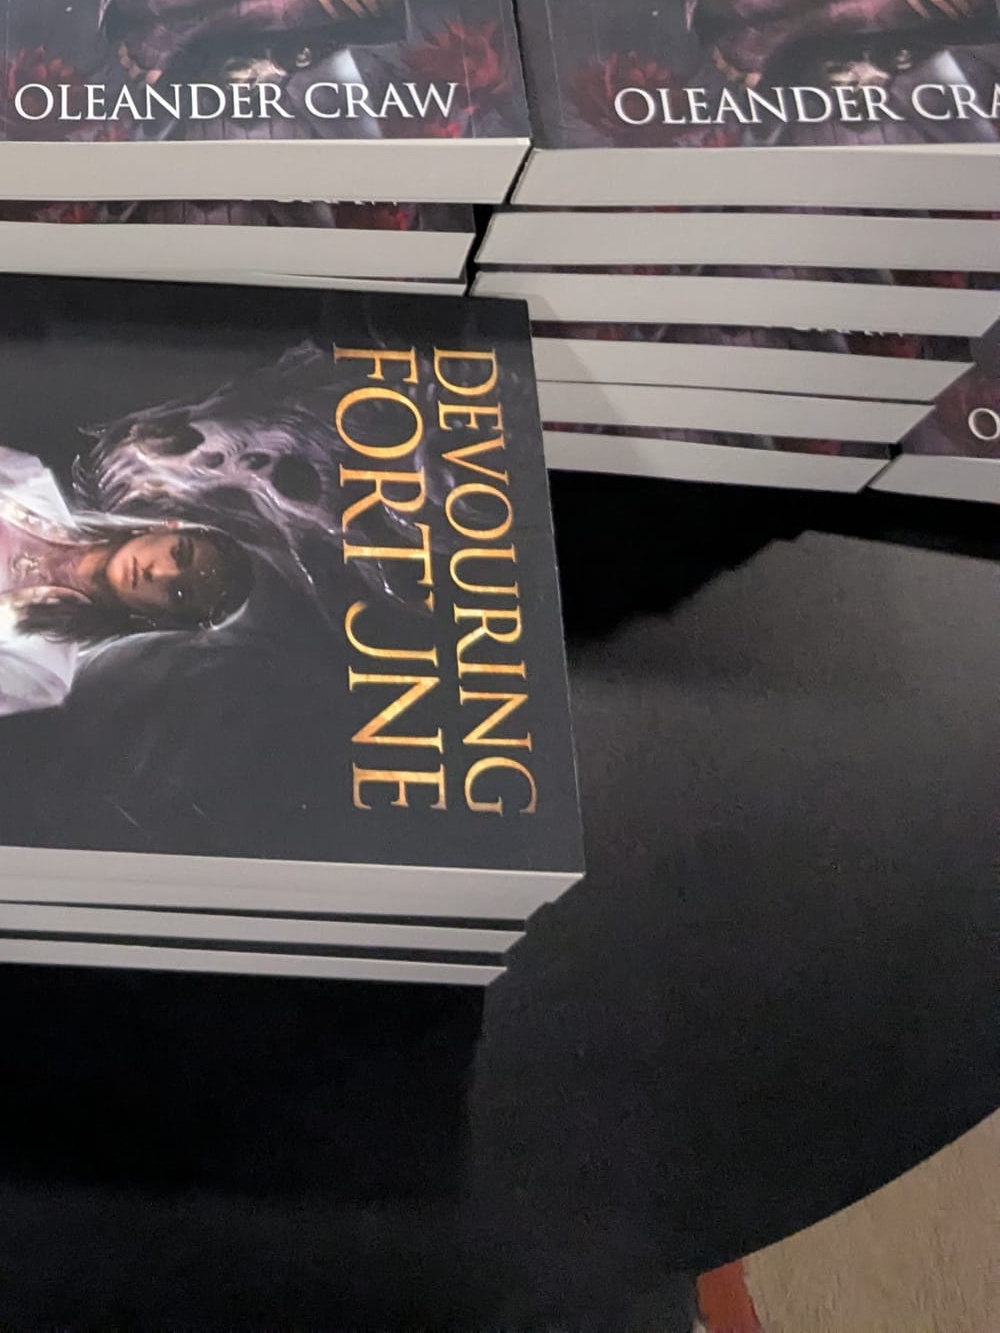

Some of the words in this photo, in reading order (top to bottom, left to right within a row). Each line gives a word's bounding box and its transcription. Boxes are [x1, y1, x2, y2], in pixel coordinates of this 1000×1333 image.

[13, 83, 293, 124] OLEANDER
[302, 81, 459, 121] CRAW
[613, 86, 904, 128] OLEANDER
[433, 346, 538, 816] DEVOURING
